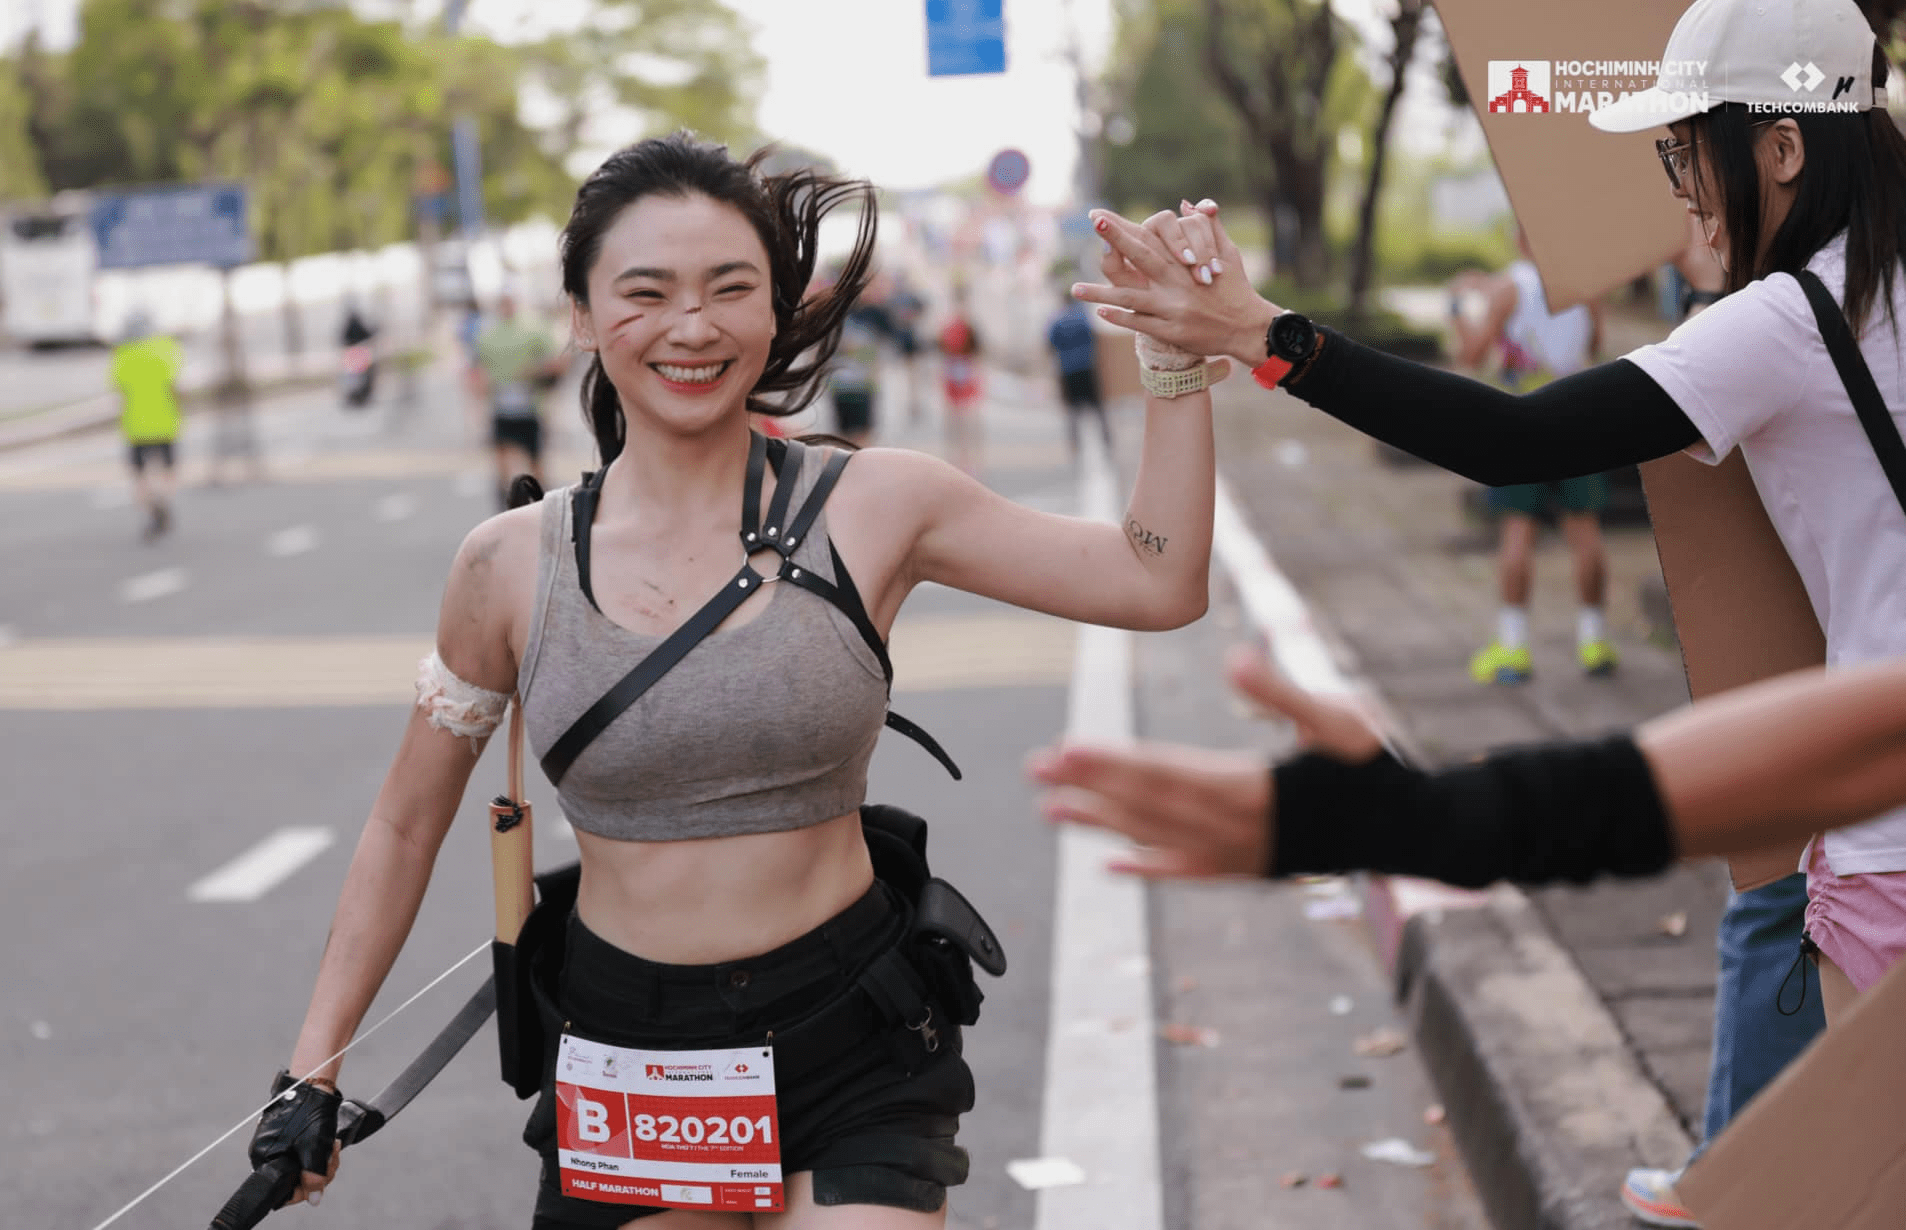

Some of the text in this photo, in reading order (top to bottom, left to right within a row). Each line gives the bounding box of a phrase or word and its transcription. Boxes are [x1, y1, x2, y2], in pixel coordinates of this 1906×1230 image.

[665, 1073, 714, 1081] MARATHON
[577, 1098, 611, 1143] B
[634, 1113, 772, 1144] 820201
[598, 1161, 619, 1171] Phan
[730, 1169, 768, 1178] Female
[571, 1178, 659, 1197] HALF MARATHON
